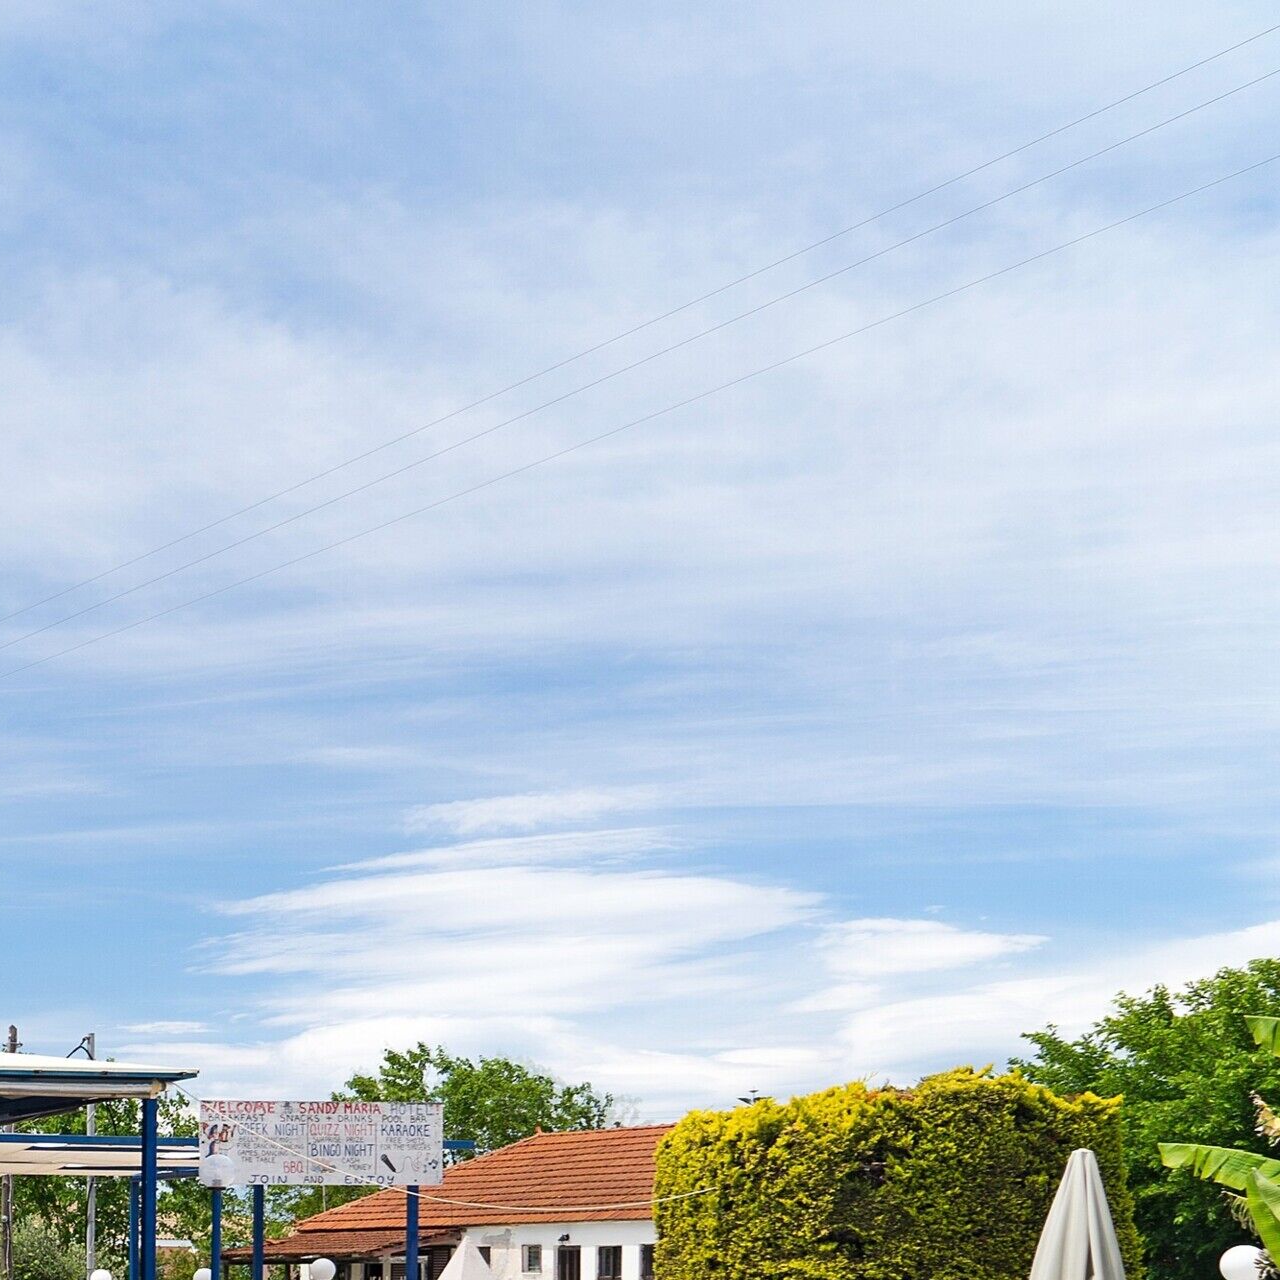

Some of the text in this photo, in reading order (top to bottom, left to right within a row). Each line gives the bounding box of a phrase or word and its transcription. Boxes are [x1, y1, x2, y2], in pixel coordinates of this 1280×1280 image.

[200, 1102, 275, 1114] WELCOME
[300, 1102, 339, 1114] SANDY
[344, 1102, 382, 1114] MARIA
[208, 1114, 264, 1122] BREAKFAST
[280, 1114, 320, 1122] SNACKS
[338, 1114, 372, 1122] DRINKS
[382, 1114, 403, 1122] POOL
[410, 1114, 427, 1122] BAR
[238, 1123, 306, 1136] GREEK NIGHT
[309, 1124, 374, 1136] QUIZZ NIGHT
[381, 1124, 430, 1136] KARAOKE
[311, 1144, 374, 1156] BINGO NIGHT
[283, 1161, 304, 1173] BBQ
[248, 1175, 395, 1184] JOIN AND ENJOY
